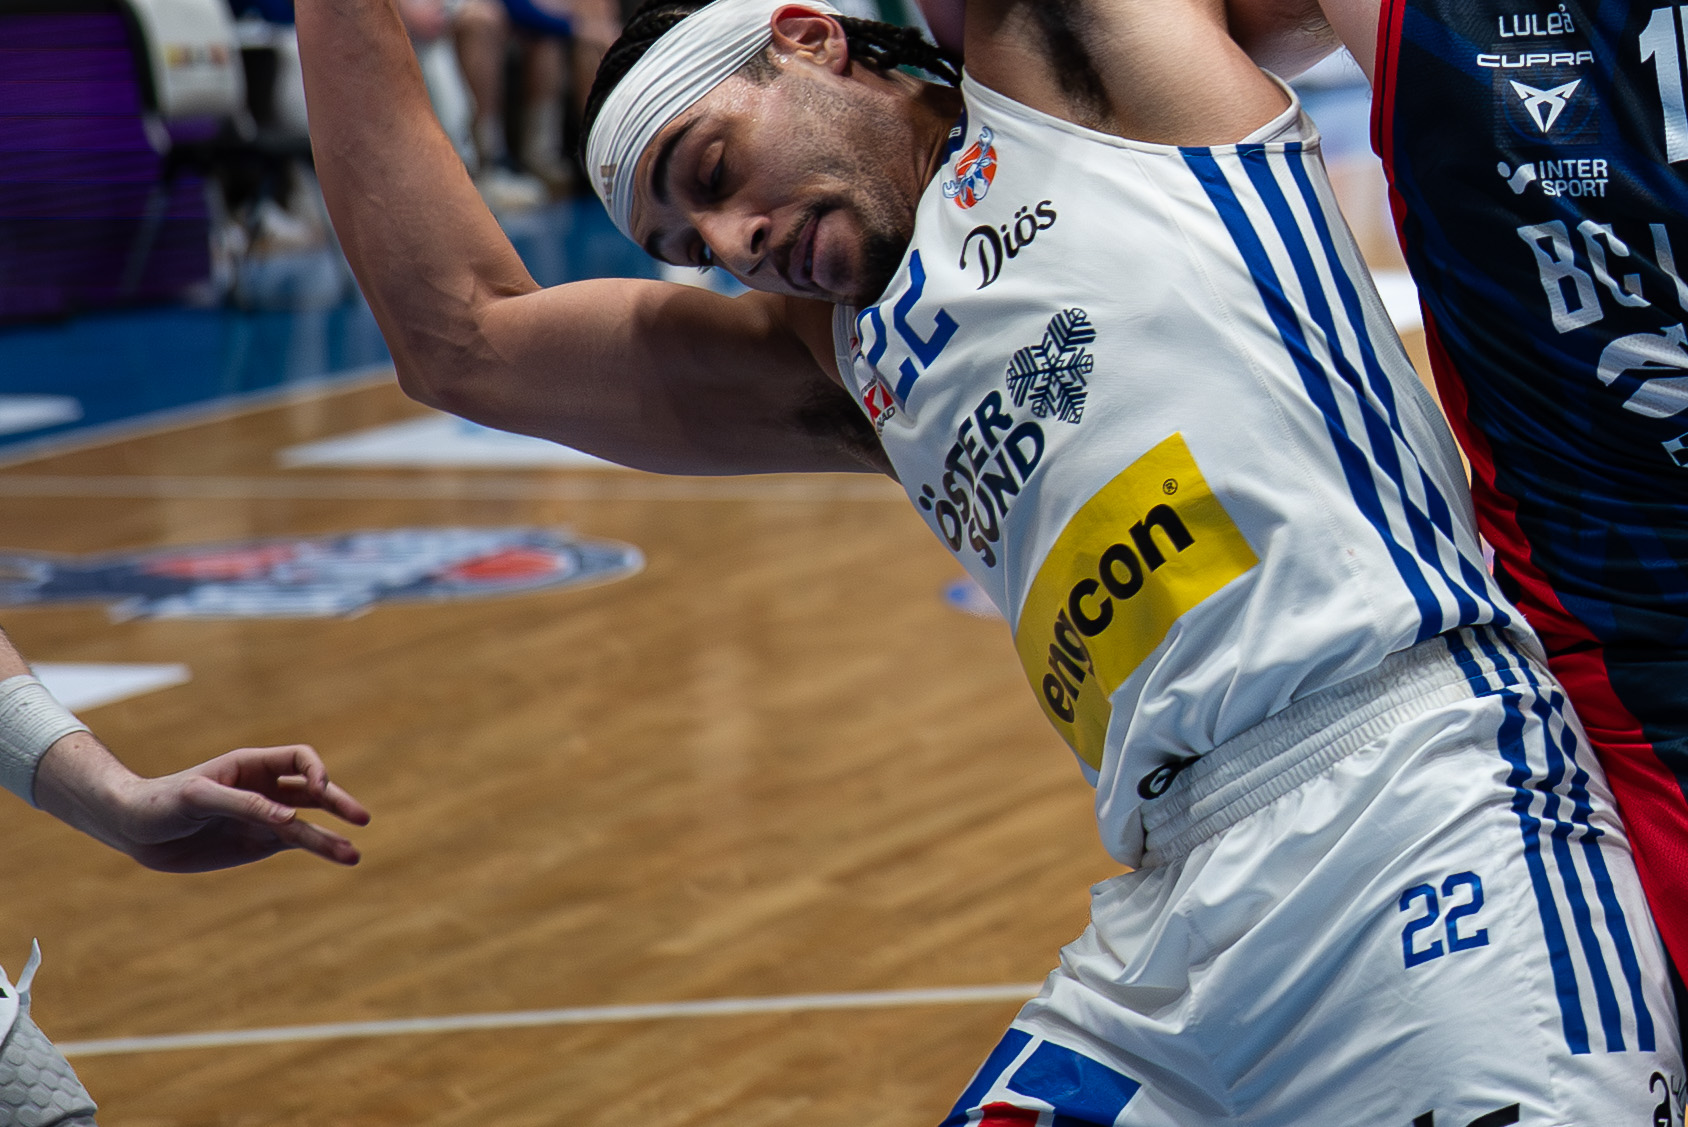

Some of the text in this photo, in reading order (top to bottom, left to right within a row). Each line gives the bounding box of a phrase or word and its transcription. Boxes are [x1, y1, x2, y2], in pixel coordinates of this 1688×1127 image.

[1476, 50, 1595, 68] CUPRA
[1539, 158, 1608, 180] INTER
[1542, 178, 1609, 198] SPORT
[959, 199, 1057, 291] Diös
[1517, 219, 1652, 334] BC
[918, 389, 1014, 553] ÖSTER
[966, 421, 1045, 569] SUND
[1042, 503, 1196, 724] engcon
[1402, 870, 1490, 970] 22
